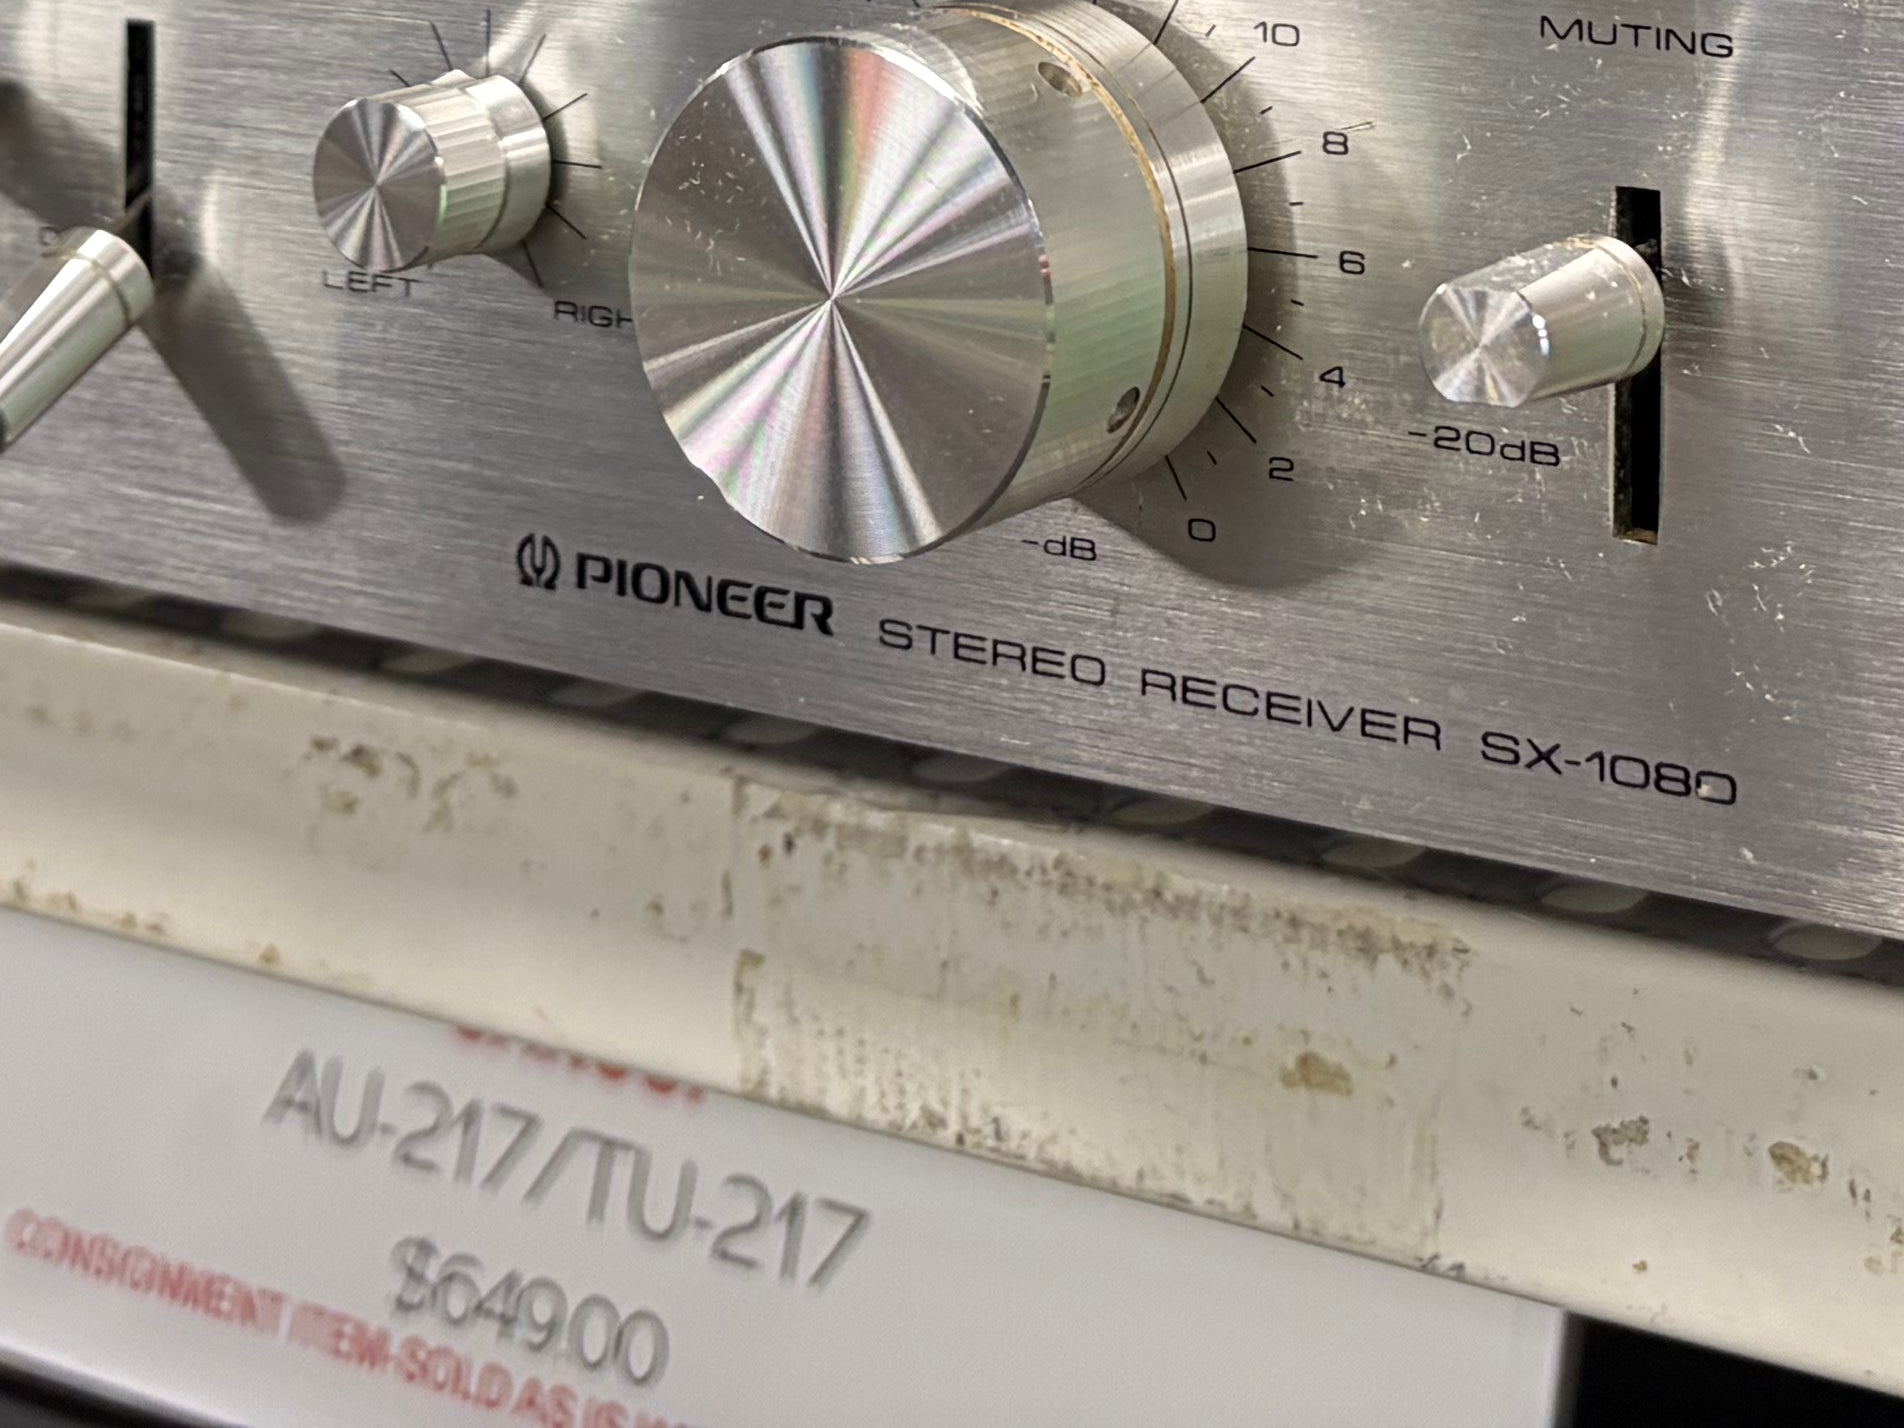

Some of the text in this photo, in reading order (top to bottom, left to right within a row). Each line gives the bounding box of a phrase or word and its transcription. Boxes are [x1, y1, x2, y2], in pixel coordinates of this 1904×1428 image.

[1253, 20, 1300, 47] 10
[1540, 15, 1734, 59] MUTING
[1321, 130, 1350, 156] 8
[1339, 250, 1366, 275] 6
[321, 270, 423, 298] LEFT
[554, 299, 633, 329] RIGH
[1318, 365, 1347, 389] 4
[1408, 425, 1561, 467] -20dB
[1268, 456, 1295, 482] 2
[1188, 517, 1217, 543] 0
[576, 550, 1738, 806] PIONEER STEREO RECEIVER SX-1080
[261, 1046, 873, 1291] AU-217/TU-217
[4, 1207, 288, 1334] CONSIGNMENT
[509, 1375, 576, 1428] AS
